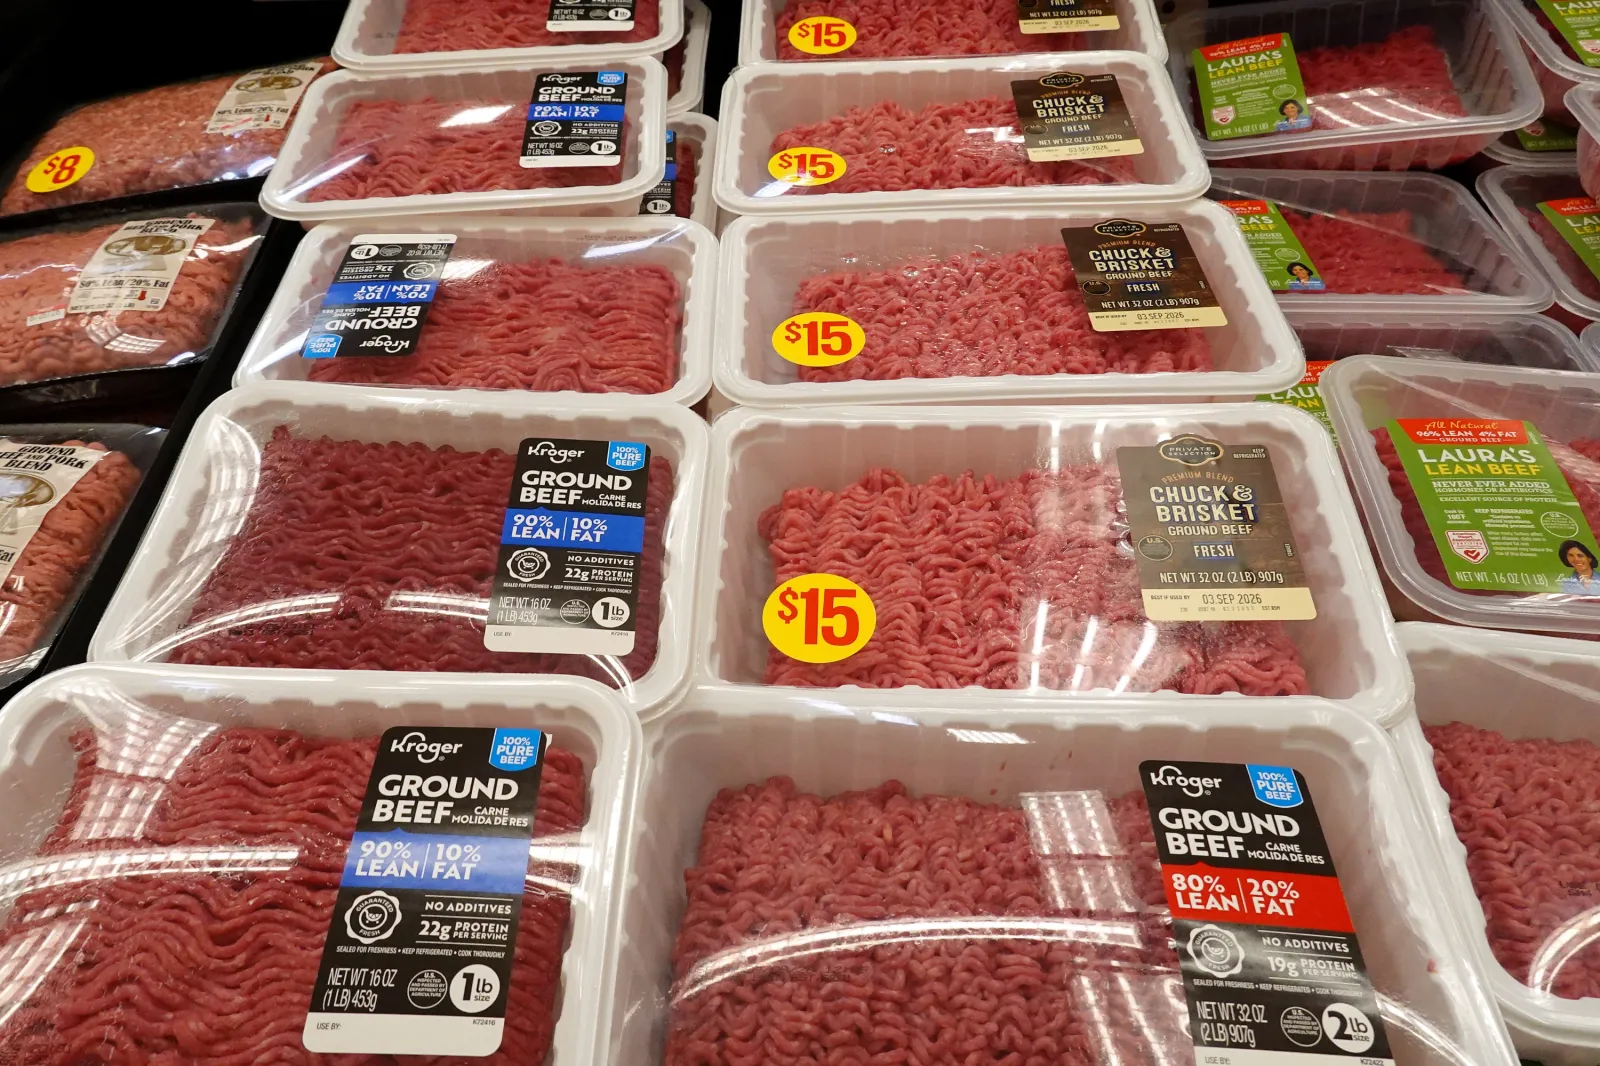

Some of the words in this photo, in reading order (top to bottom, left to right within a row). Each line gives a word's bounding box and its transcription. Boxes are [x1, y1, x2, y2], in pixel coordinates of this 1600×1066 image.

[797, 23, 846, 47] $15
[1208, 51, 1282, 72] LAURA'S
[1209, 65, 1245, 78] LEAN
[1249, 59, 1284, 73] BEEF
[543, 74, 582, 84] Kroger
[1032, 96, 1087, 109] CHUCK
[1037, 104, 1105, 118] BRISKET
[1062, 124, 1090, 133] FRESH
[44, 155, 81, 184] $8
[779, 153, 834, 179] $15
[1089, 248, 1152, 261] CHUCK
[1095, 258, 1174, 272] BRISKET
[1127, 283, 1160, 292] FRESH
[369, 306, 421, 317] BEEF
[1101, 300, 1115, 309] NET
[325, 318, 417, 331] GROUND
[360, 335, 410, 353] Kroger
[784, 321, 852, 356] $15
[1425, 421, 1444, 431] All
[19, 446, 76, 456] GROUND
[528, 442, 584, 464] Kroger
[1418, 447, 1536, 463] LAURA'S
[4, 460, 52, 471] BLEND
[44, 455, 88, 469] PORK
[1425, 464, 1484, 475] LEAN
[1489, 465, 1540, 476] BEEF
[522, 470, 632, 491] GROUND
[1161, 471, 1201, 484] PREMIUM
[1206, 472, 1234, 483] BLEND
[520, 487, 582, 504] BEEF
[1150, 485, 1229, 503] CHUCK
[1156, 504, 1256, 522] BRISKET
[513, 515, 553, 527] 90%
[572, 518, 608, 530] 10%
[511, 526, 560, 539] LEAN
[570, 529, 605, 542] FAT
[1168, 525, 1218, 536] GROUND
[1222, 524, 1253, 534] BEEF
[1193, 544, 1235, 557] FRESH
[1160, 572, 1178, 583] NET
[1180, 572, 1196, 583] WT
[1199, 572, 1209, 583] 32
[1212, 572, 1225, 583] OZ
[1456, 572, 1473, 582] NET
[778, 587, 859, 646] $15
[391, 732, 462, 763] Kroger
[503, 737, 530, 746] 100%
[496, 745, 534, 756] PURE
[500, 756, 527, 765] BEEF
[1150, 765, 1222, 797] Kroger
[1257, 772, 1287, 781] 100%
[378, 775, 518, 800] GROUND
[1256, 780, 1295, 792] PURE
[1266, 791, 1292, 800] BEEF
[372, 800, 453, 823] BEEF
[475, 806, 509, 816] CARNE
[452, 815, 492, 825] MOLIDA
[510, 817, 528, 827] RES
[1159, 808, 1300, 836] GROUND
[361, 841, 411, 858] 90%
[436, 844, 480, 862] 10%
[1165, 833, 1244, 859] BEEF
[1266, 842, 1301, 852] CARNE
[1248, 850, 1288, 862] MOLIDA
[1288, 854, 1304, 863] DE
[1306, 855, 1324, 864] RES
[355, 860, 418, 878] LEAN
[432, 862, 476, 880] FAT
[1172, 873, 1225, 892] 80%
[1246, 879, 1299, 899] 20%
[425, 902, 443, 911] NO
[446, 902, 511, 914] ADDITIVES
[1176, 892, 1240, 911] LEAN
[1253, 898, 1294, 915] FAT
[454, 922, 508, 933] PROTEIN
[1262, 937, 1280, 946] NO
[1285, 938, 1349, 953] ADDITIVES
[1301, 959, 1354, 971] PROTEIN
[328, 968, 351, 985] NET
[350, 968, 369, 986] WT
